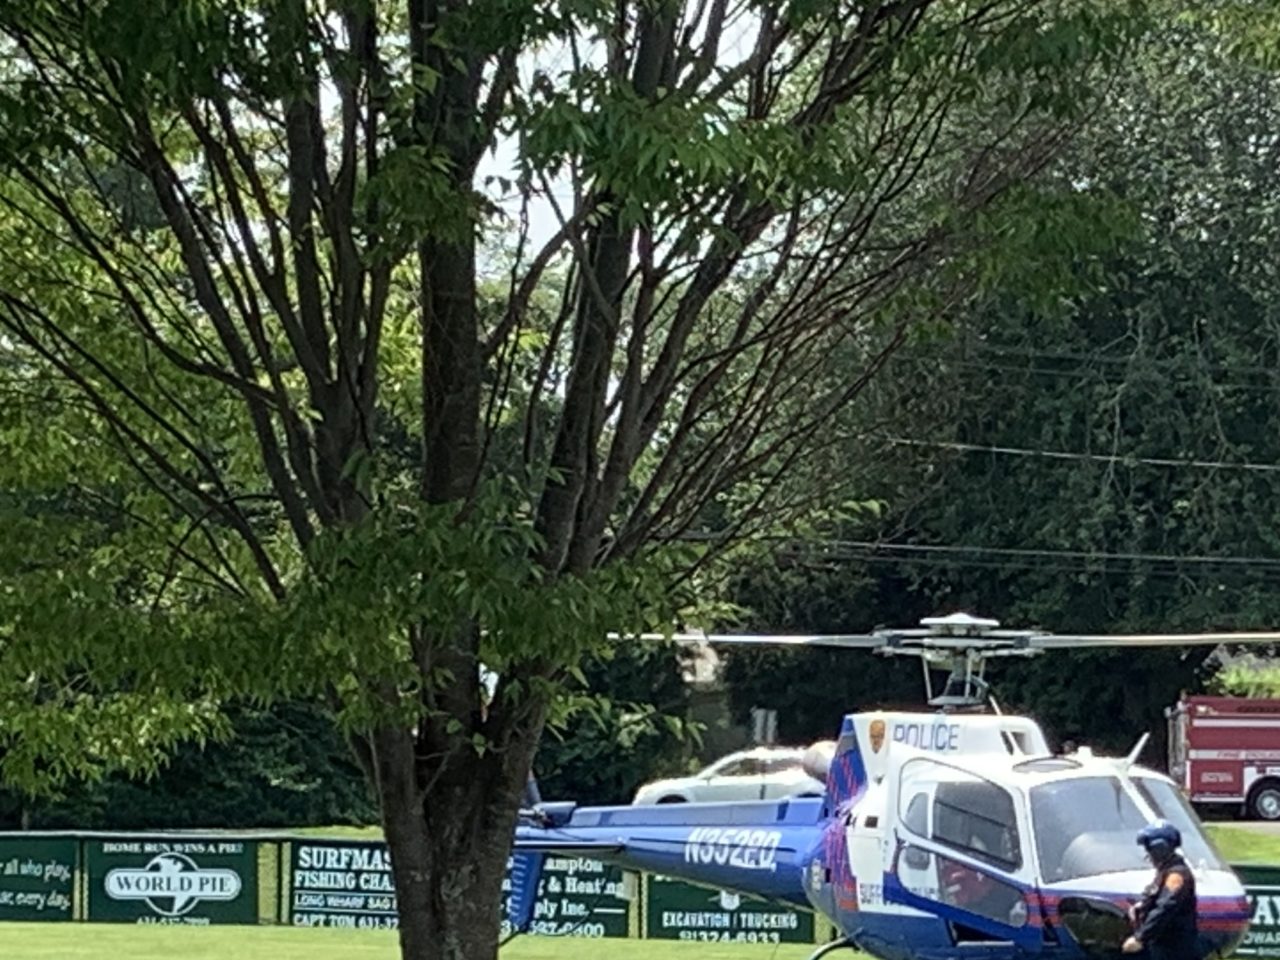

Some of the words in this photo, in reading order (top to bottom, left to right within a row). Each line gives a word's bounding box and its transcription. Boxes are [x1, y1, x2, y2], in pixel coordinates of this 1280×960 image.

[893, 724, 960, 751] POLICE
[103, 843, 142, 853] HOME
[144, 843, 170, 853] RUN
[172, 843, 206, 854] WINS
[207, 843, 217, 853] A
[298, 846, 393, 871] SURFMAS
[116, 876, 193, 891] WORLD
[200, 876, 232, 892] PIE
[294, 870, 357, 890] FISHING
[359, 873, 396, 891] CHA
[547, 876, 562, 893] &
[662, 911, 731, 927] EXCAVATION
[740, 912, 798, 929] TRUCKING
